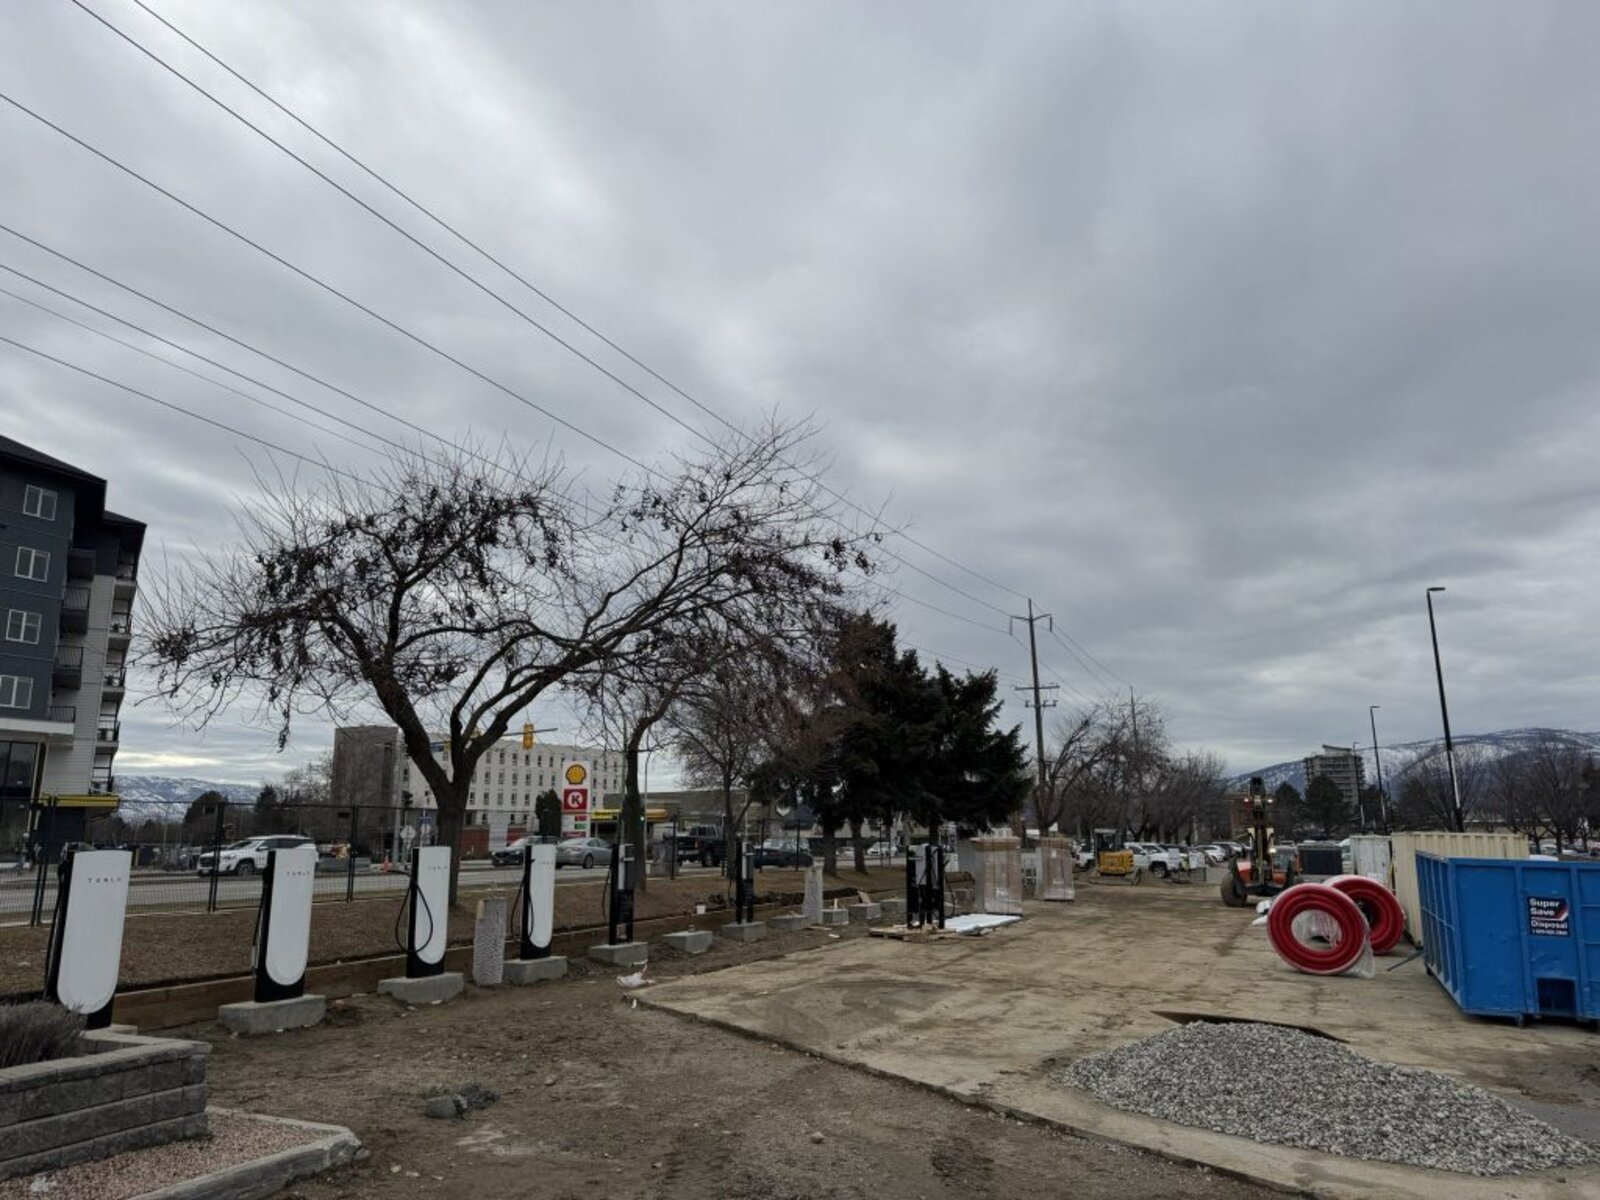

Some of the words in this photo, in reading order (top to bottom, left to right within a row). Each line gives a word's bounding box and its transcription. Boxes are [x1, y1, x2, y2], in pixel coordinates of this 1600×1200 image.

[1529, 898, 1560, 908] Super
[1530, 907, 1555, 916] Save
[1531, 920, 1568, 929] Disposal
